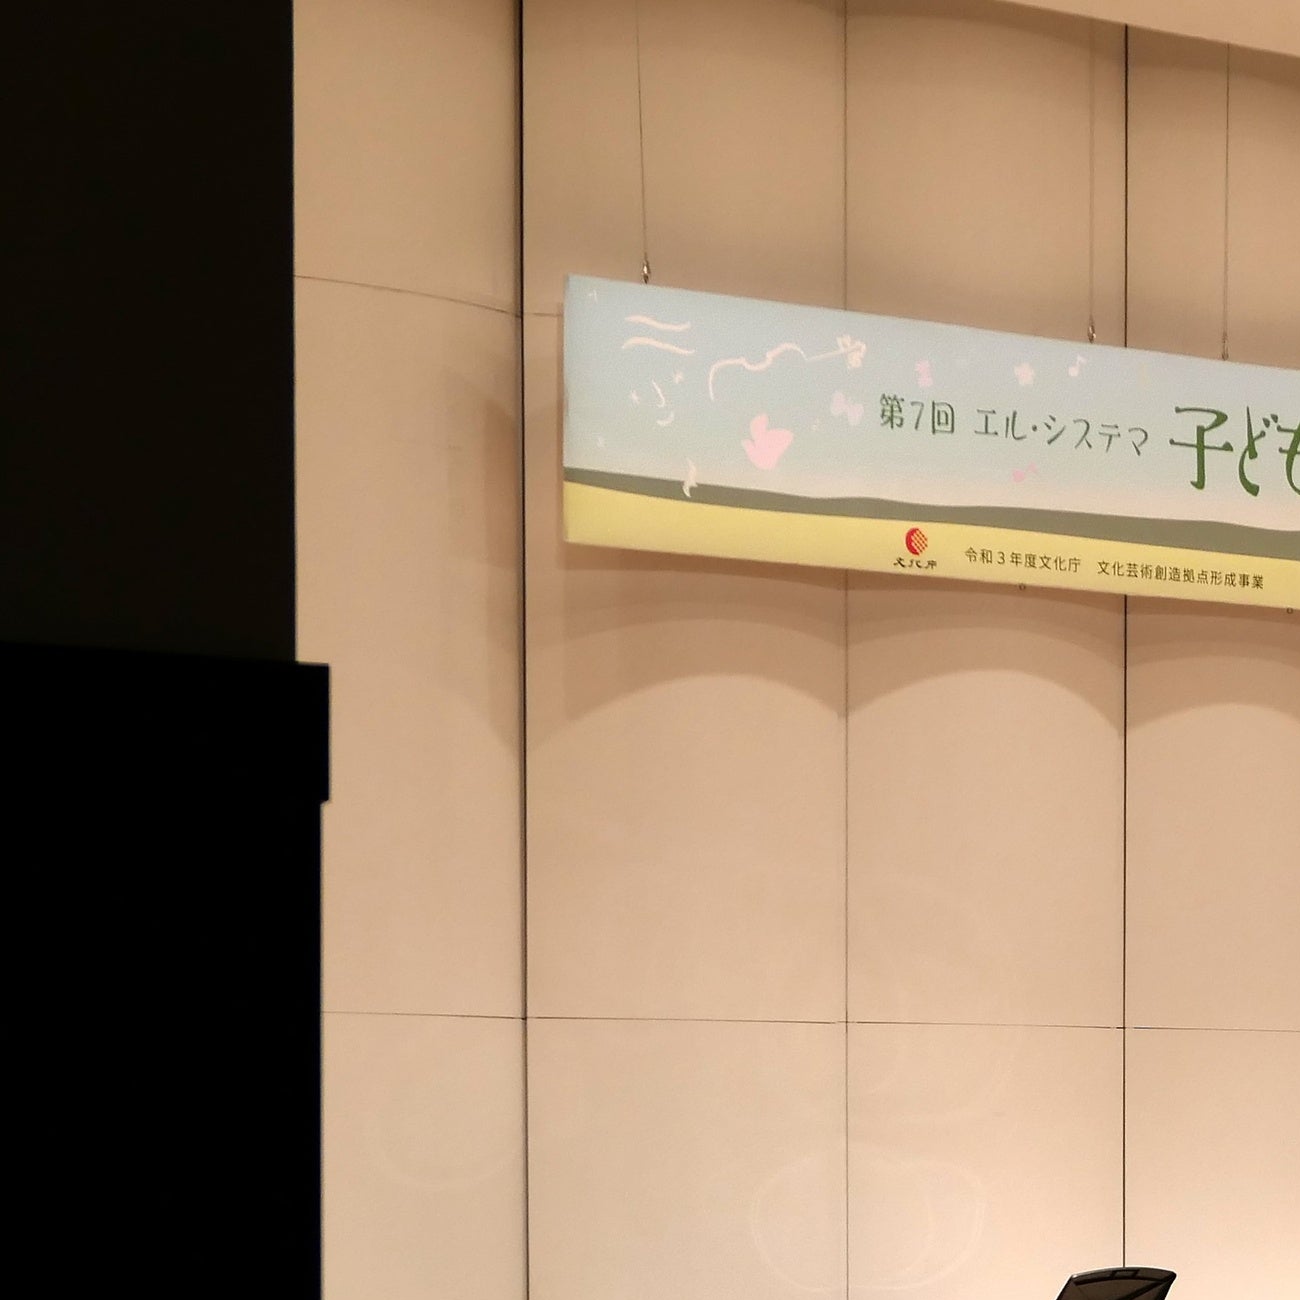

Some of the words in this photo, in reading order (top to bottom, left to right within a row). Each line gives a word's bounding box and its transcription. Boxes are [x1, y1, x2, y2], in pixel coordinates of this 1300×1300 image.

[880, 393, 955, 434] 第7回
[1098, 561, 1264, 590] 文化芸術創造拠点形成事業
